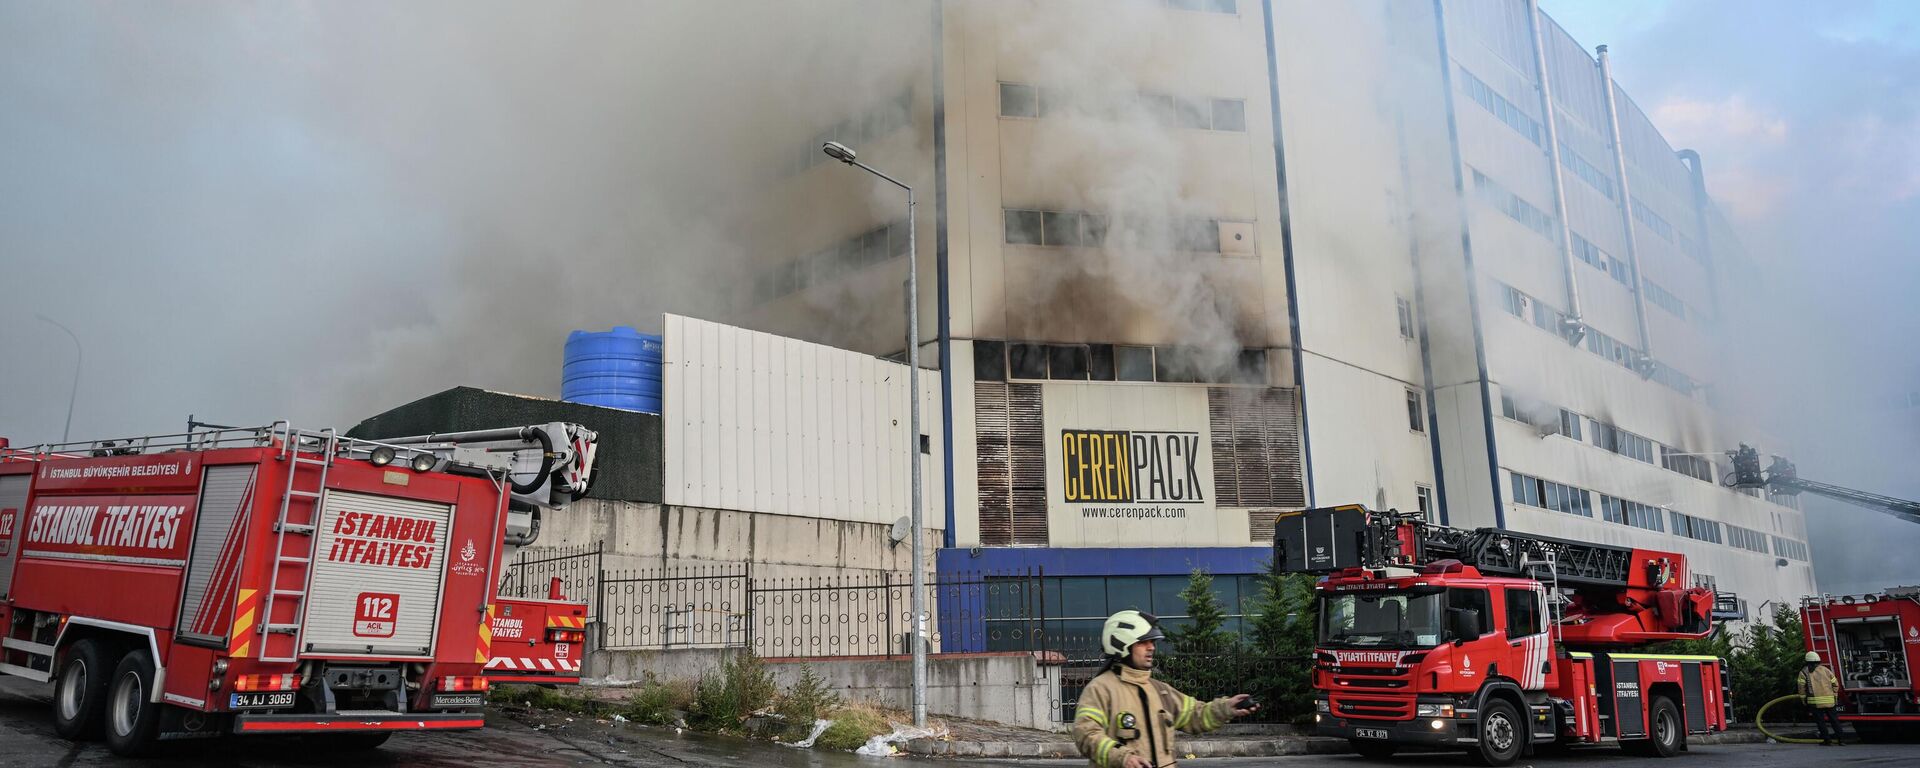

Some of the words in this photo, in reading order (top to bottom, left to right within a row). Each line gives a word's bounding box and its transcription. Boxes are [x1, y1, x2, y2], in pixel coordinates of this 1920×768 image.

[83, 464, 130, 479] BÜYÜKŞEHİR
[1082, 506, 1186, 519] www.cerenpack.com
[0, 514, 13, 535] 112
[363, 597, 392, 618] 112
[237, 695, 249, 706] 34
[252, 695, 265, 705] AJ
[268, 693, 292, 704] 3069
